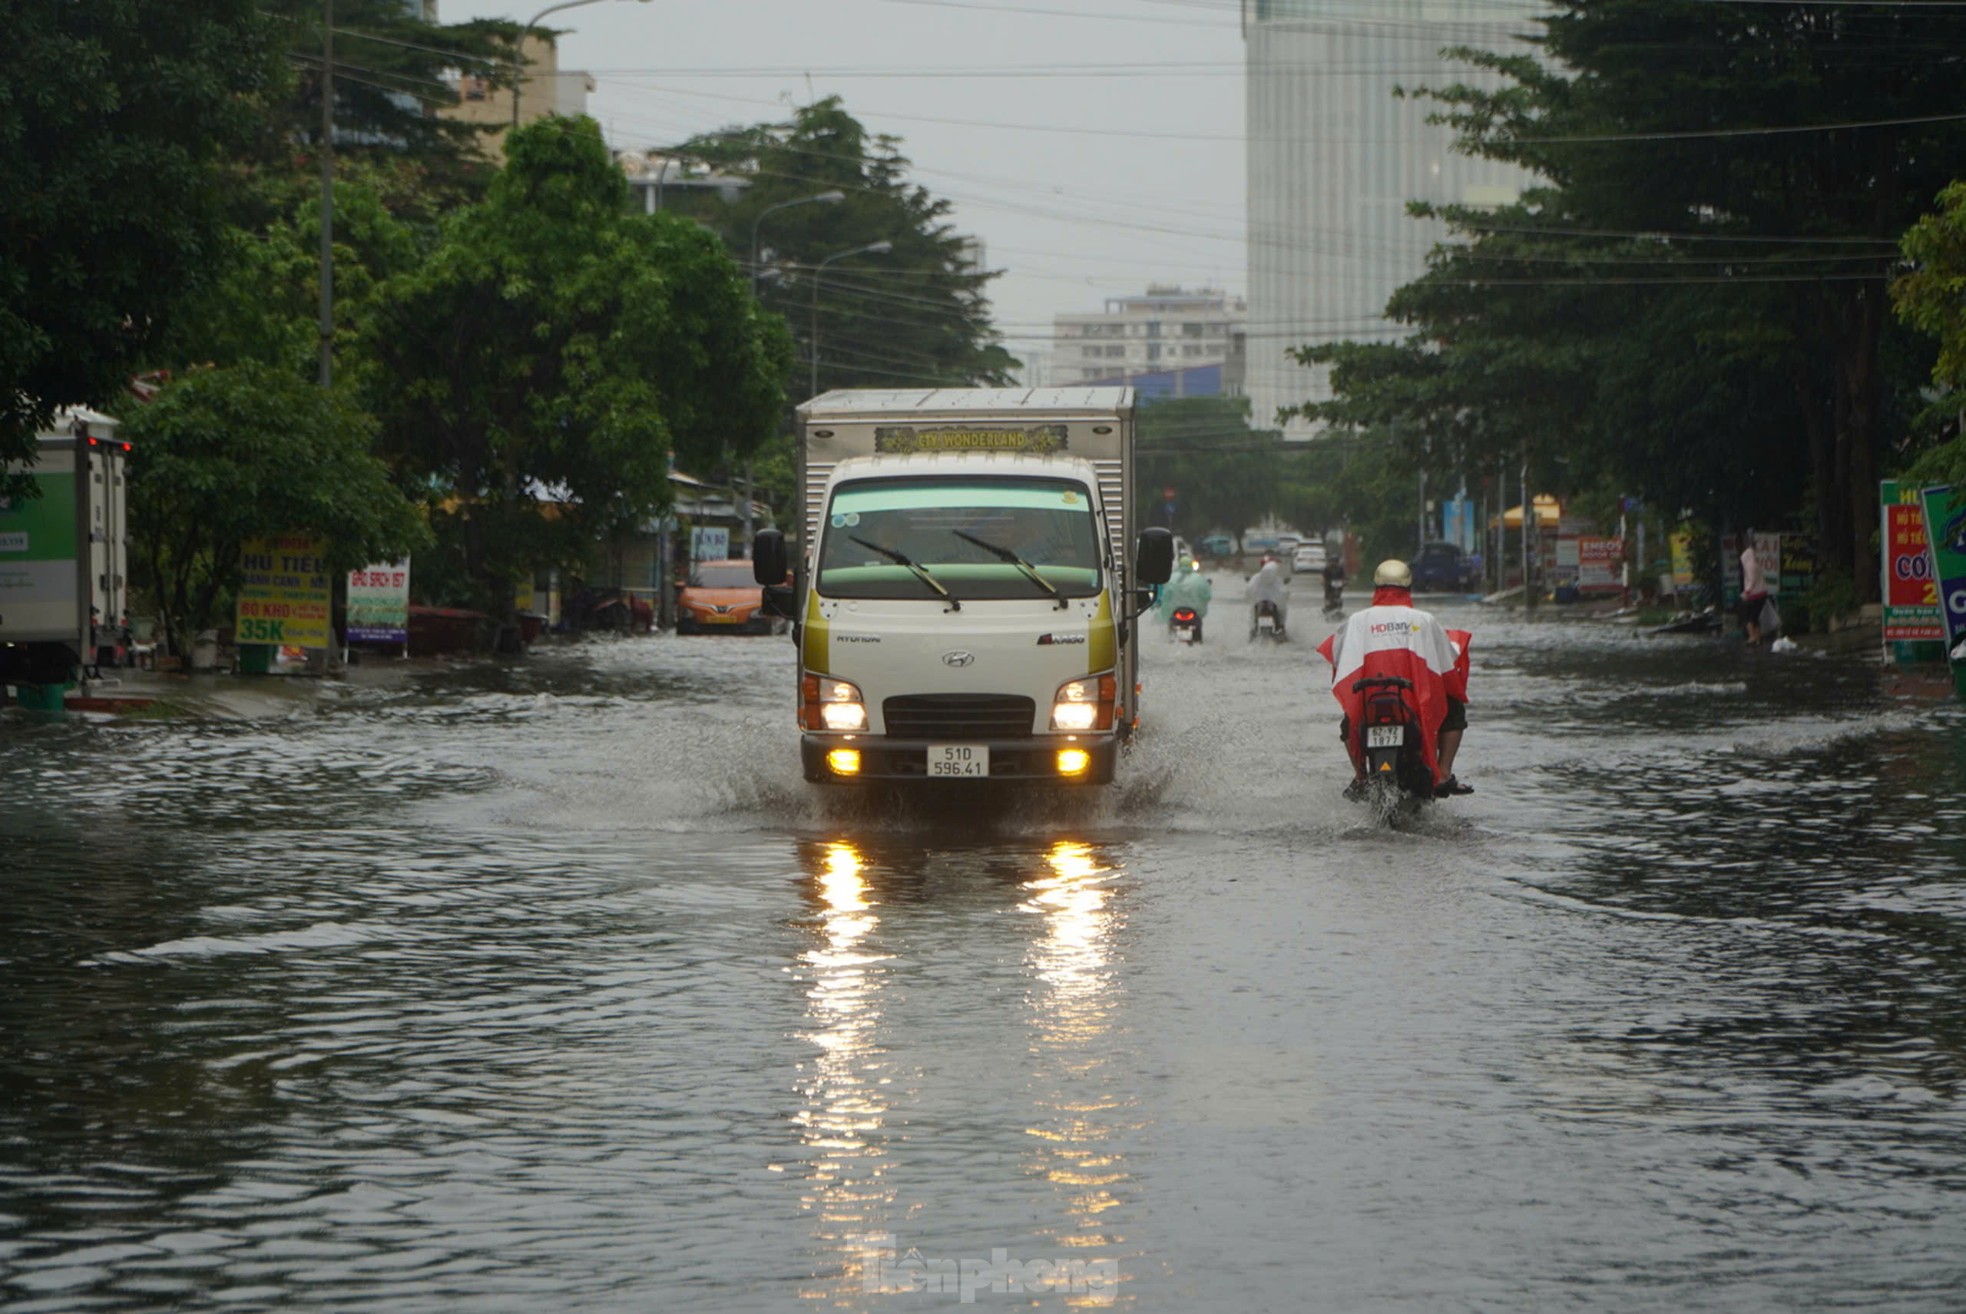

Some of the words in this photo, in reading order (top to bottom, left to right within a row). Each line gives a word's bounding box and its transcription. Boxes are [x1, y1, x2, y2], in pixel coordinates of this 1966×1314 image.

[944, 431, 1025, 448] WONDERLAND
[240, 619, 284, 640] 35K
[836, 634, 881, 643] HYUNDAI
[1373, 736, 1397, 745] 1877
[945, 747, 971, 761] 51D
[934, 762, 981, 775] 596.41
